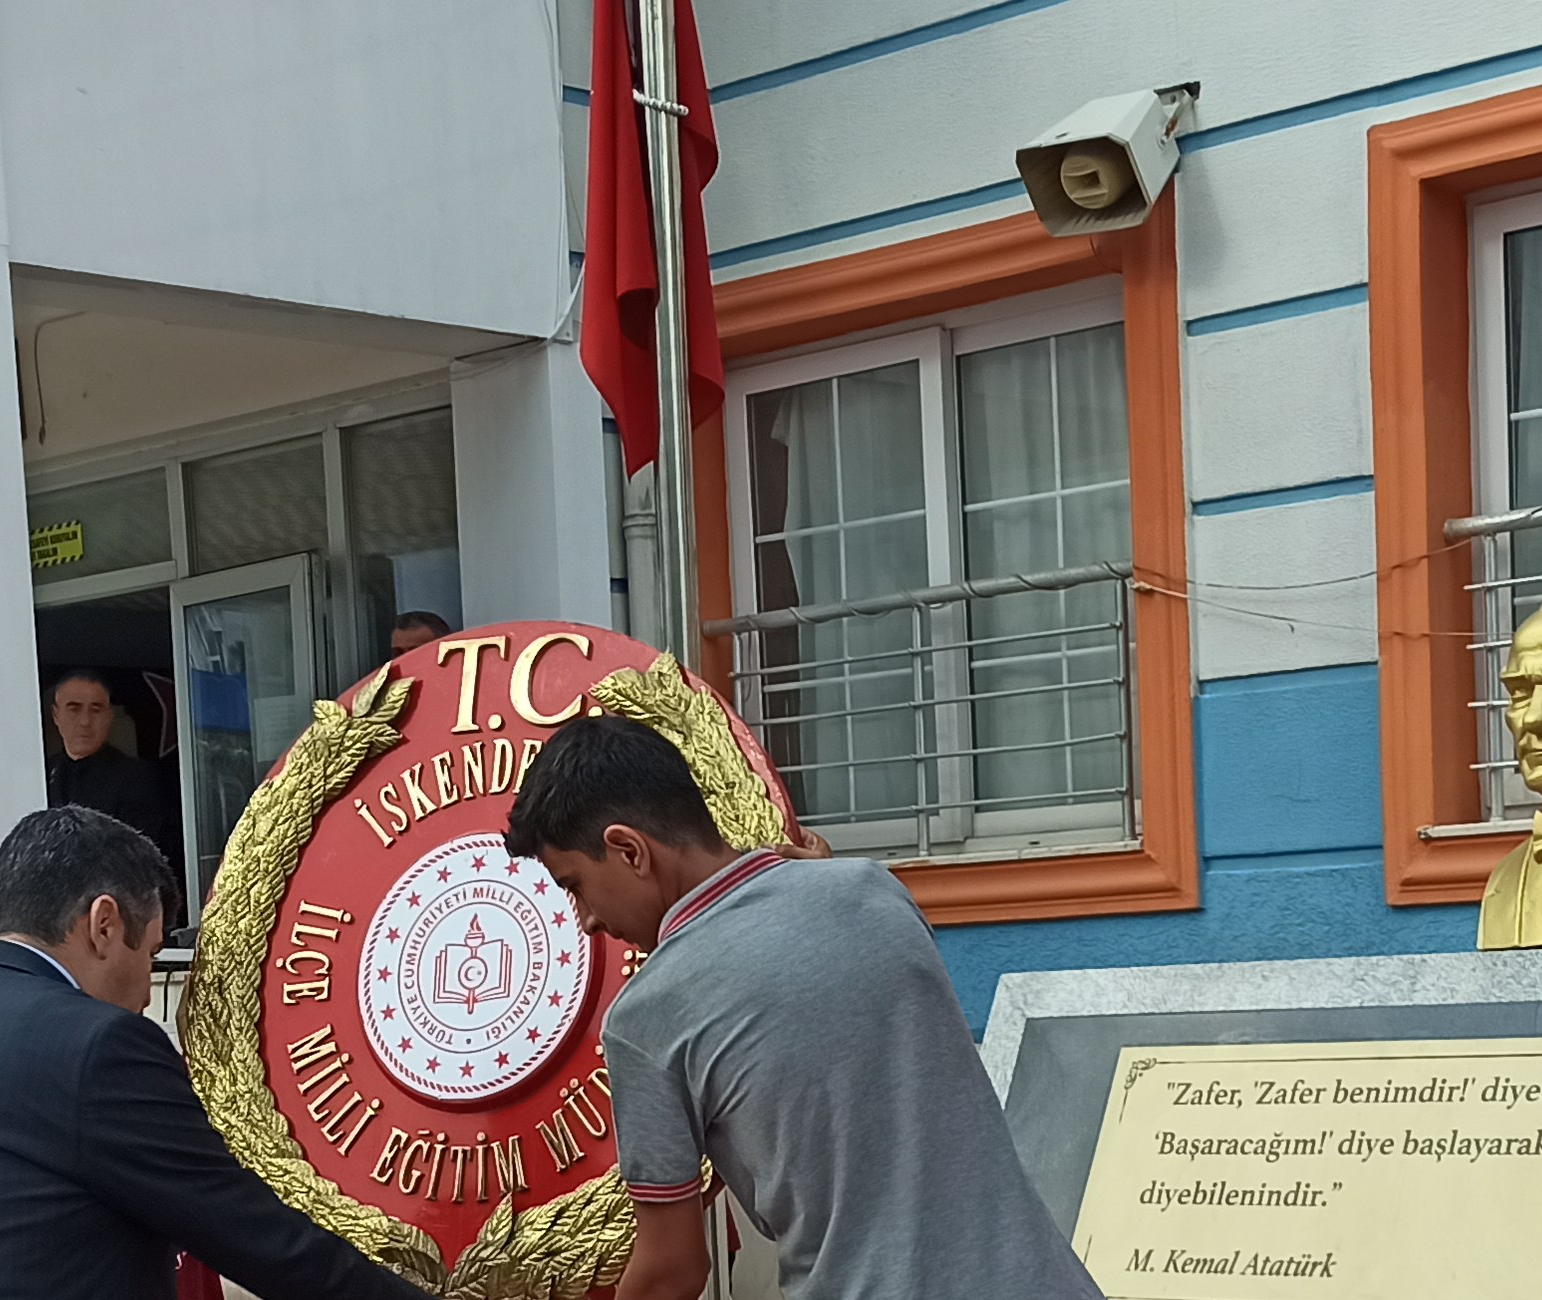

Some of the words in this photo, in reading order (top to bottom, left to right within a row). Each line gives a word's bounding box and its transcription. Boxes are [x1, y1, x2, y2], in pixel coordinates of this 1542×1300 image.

[353, 738, 543, 849] İSKENDE
[473, 885, 514, 905] MİLLİ
[514, 900, 544, 953] EĞİTİM
[275, 900, 352, 1004] İLÇE
[404, 887, 467, 989] CUMHURİYETİ
[407, 994, 454, 1045] TÜRKİYE
[485, 961, 544, 1041] BAKANLIĞI
[287, 1023, 381, 1157] MİLLİ
[370, 1126, 530, 1203] EĞİTİM
[1338, 1131, 1395, 1163] diye
[1125, 1248, 1156, 1273] M.
[1162, 1249, 1240, 1275] Kemal
[1240, 1252, 1338, 1278] Atatürk
